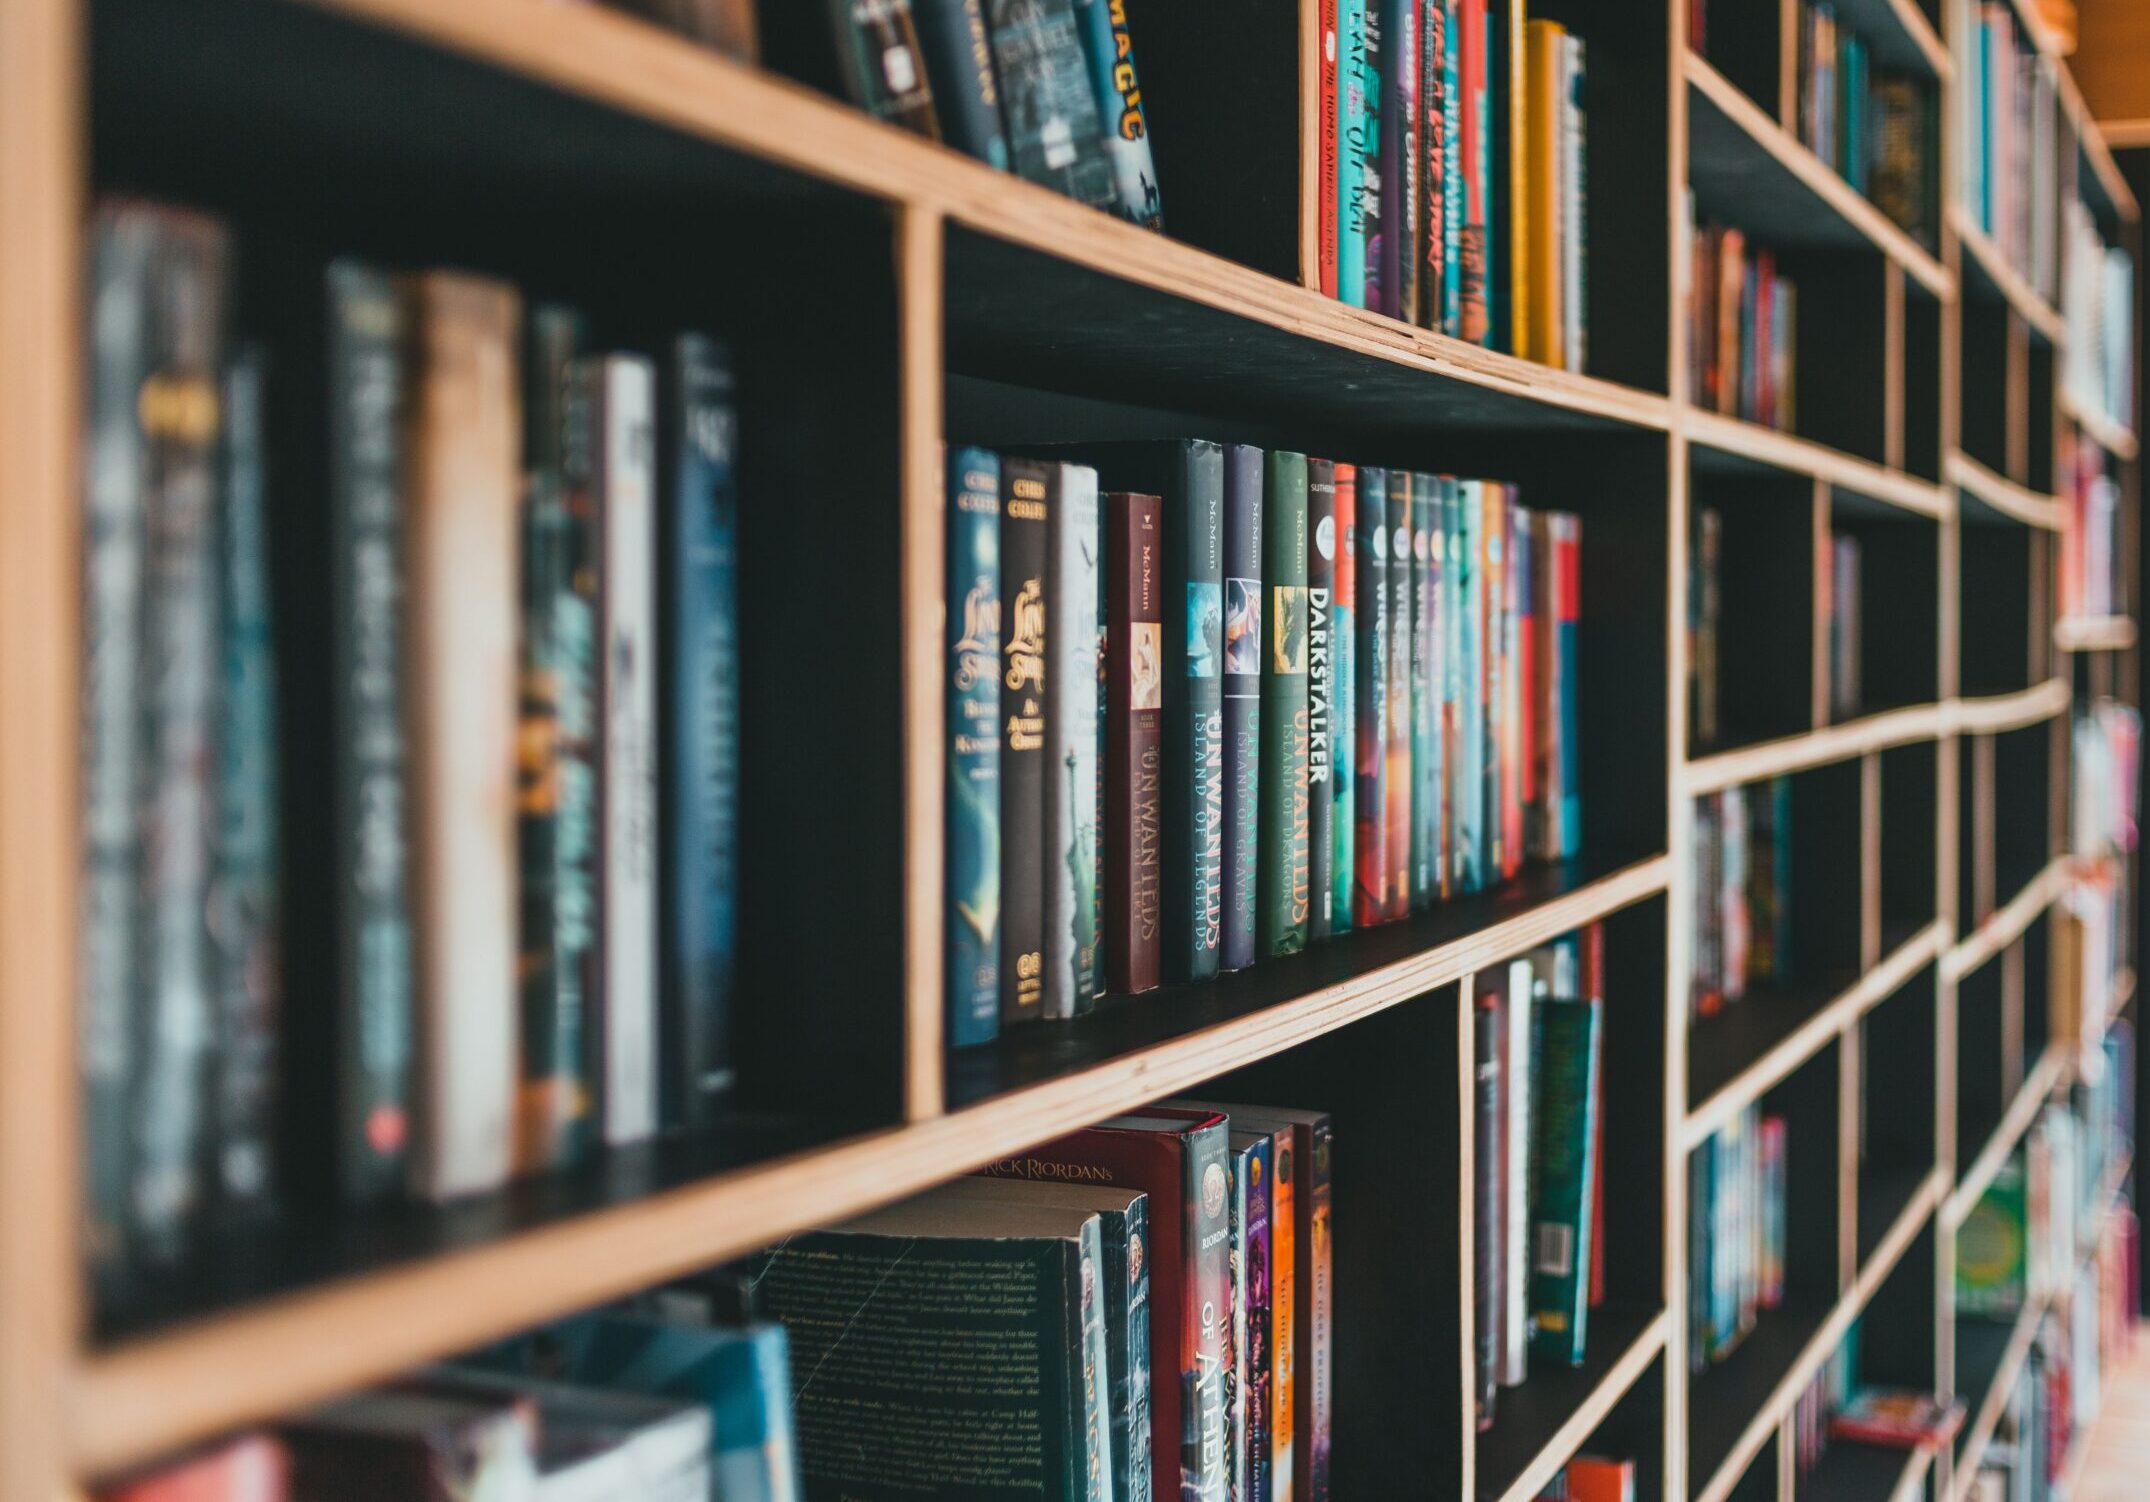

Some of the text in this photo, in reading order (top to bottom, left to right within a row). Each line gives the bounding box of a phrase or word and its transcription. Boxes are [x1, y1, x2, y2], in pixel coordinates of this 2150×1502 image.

[1327, 62, 1336, 89] THE
[1327, 94, 1336, 139] HOMO
[1209, 499, 1217, 570] McMann
[1252, 501, 1260, 570] McMann
[1296, 510, 1304, 575] McMann
[1142, 545, 1151, 611] McMann
[1309, 587, 1330, 786] DARKSTALKER
[1142, 750, 1160, 941] UNWANTEDS
[1195, 712, 1207, 951] ISLAND OF LEGENDS
[1206, 714, 1222, 950] UNWANTEDS
[1235, 731, 1249, 912] ISLAND OF GRAVES
[1283, 723, 1294, 910] ISLAND OF DRAGONS
[1292, 710, 1309, 924] UNWANTEDS
[1202, 1226, 1228, 1249] RIORDAN
[1202, 1300, 1214, 1340] OF
[1218, 1305, 1229, 1361] THE
